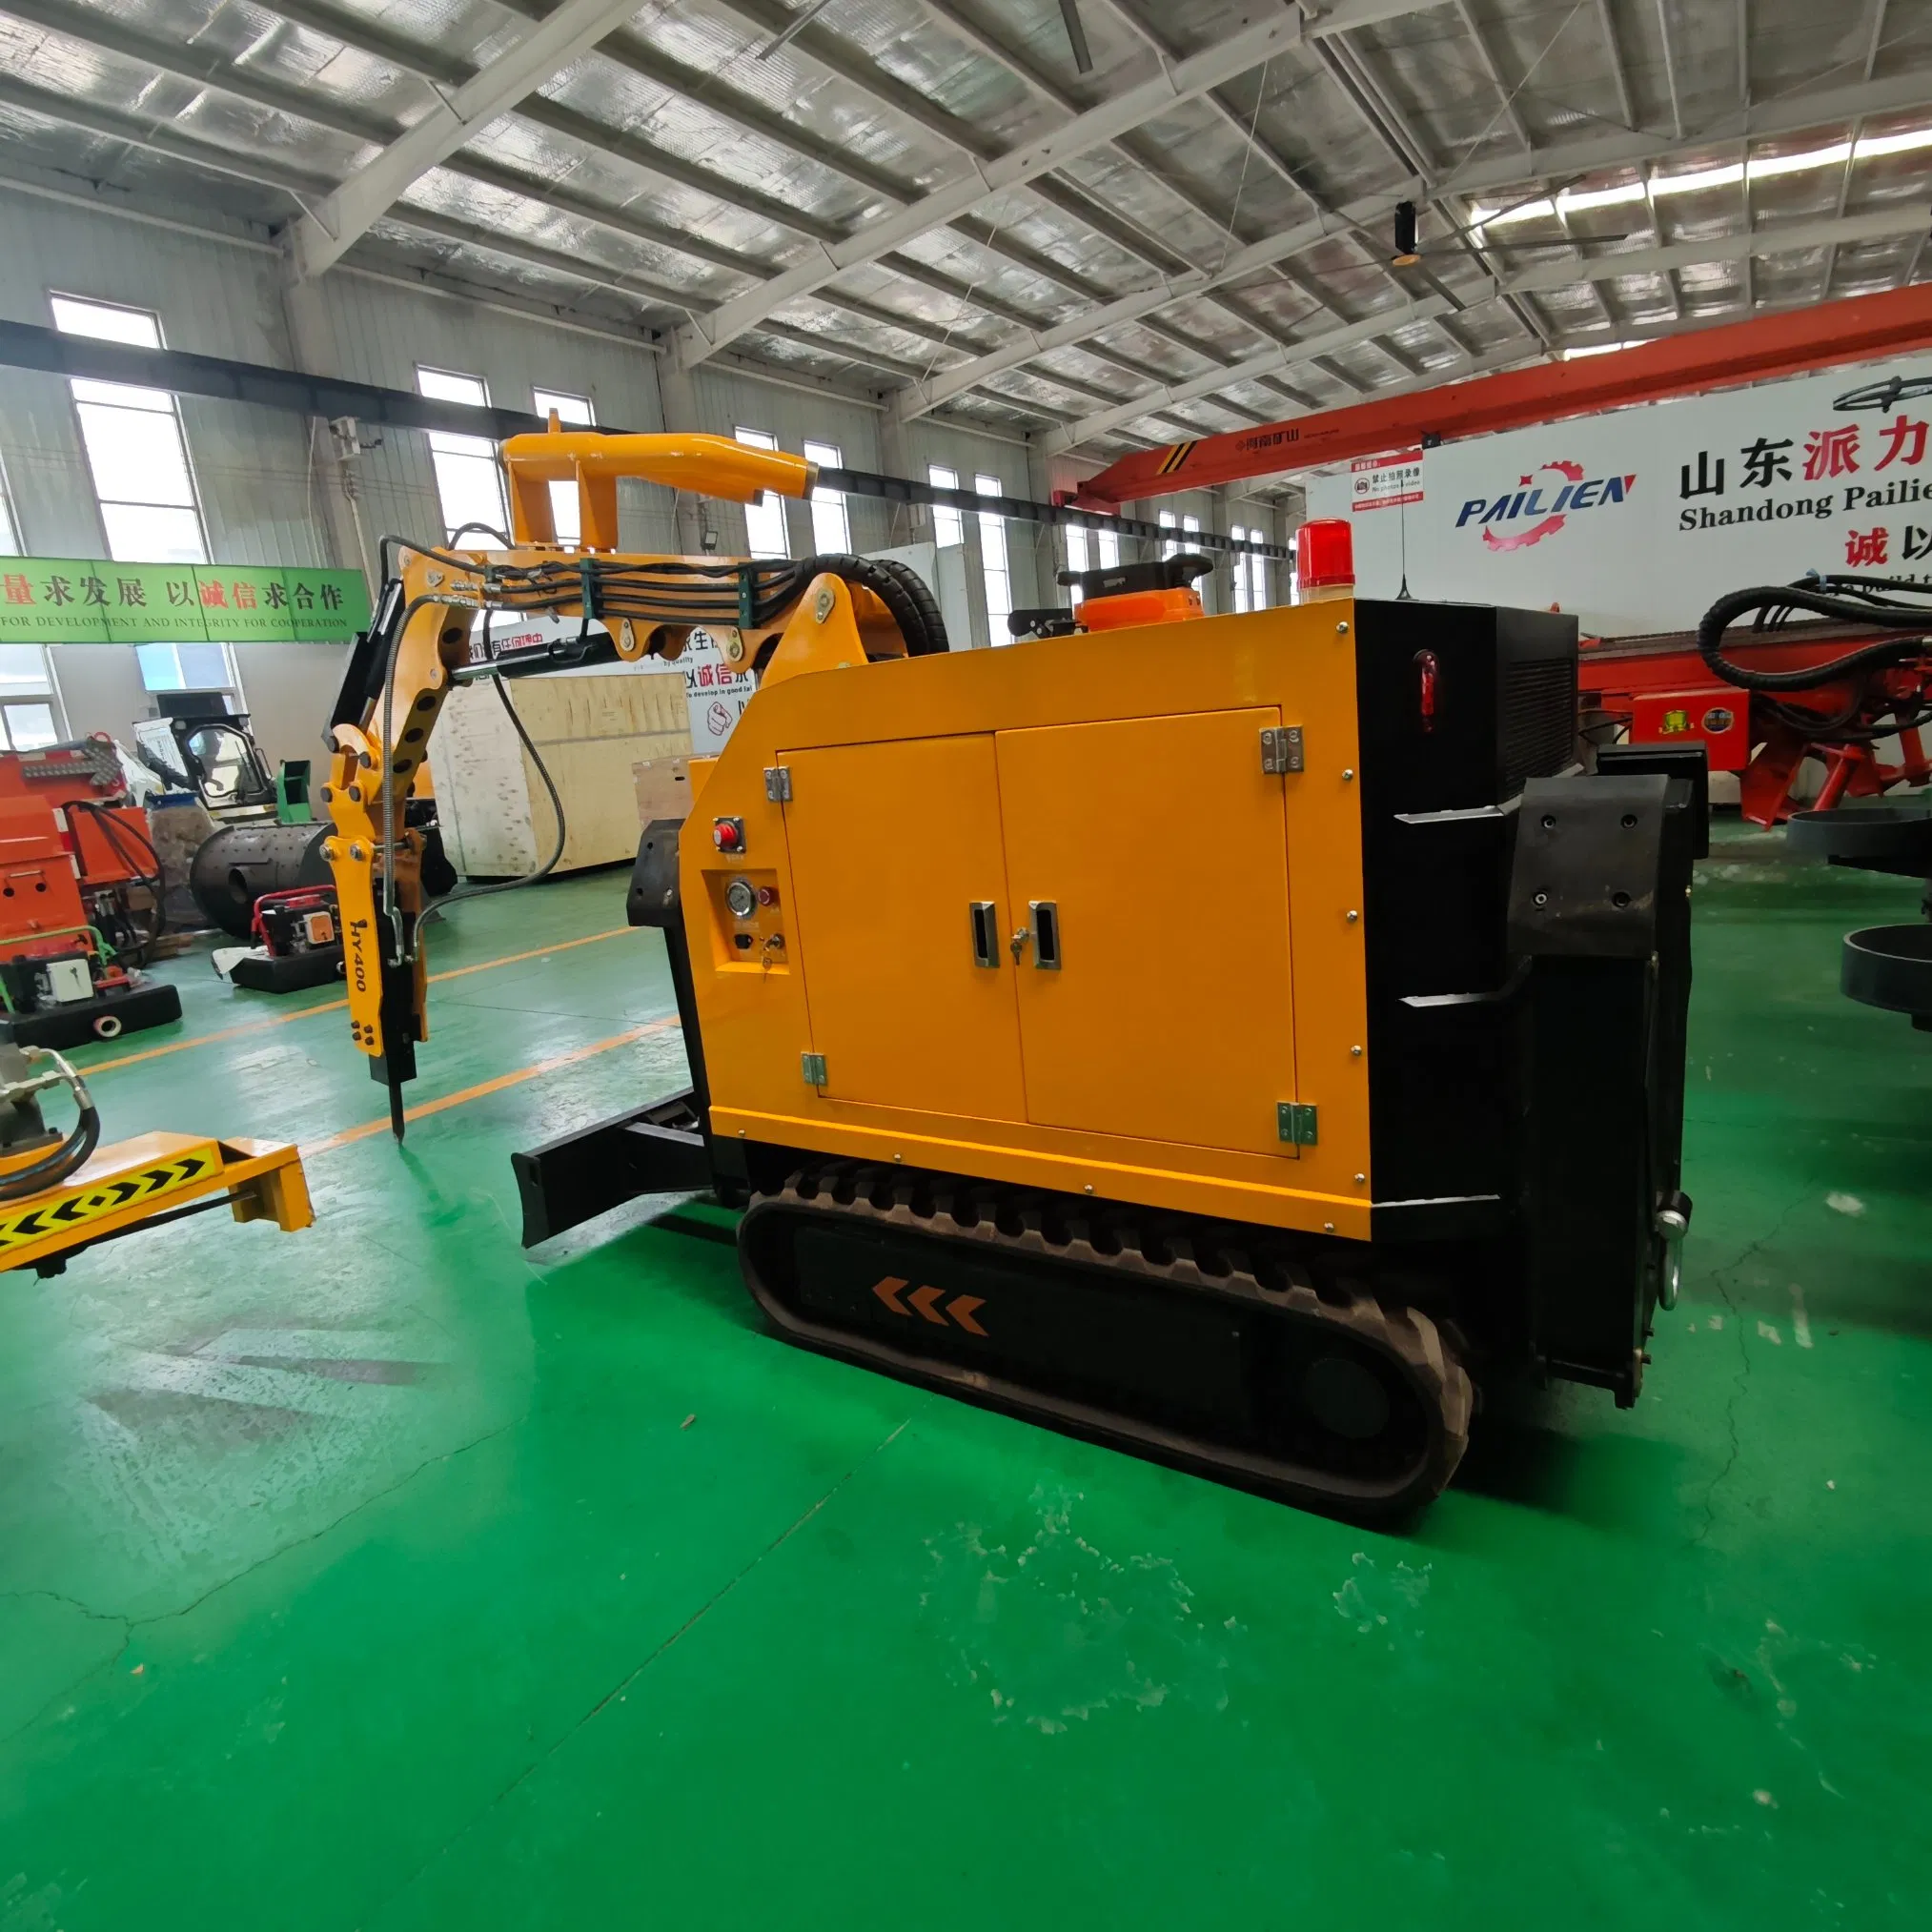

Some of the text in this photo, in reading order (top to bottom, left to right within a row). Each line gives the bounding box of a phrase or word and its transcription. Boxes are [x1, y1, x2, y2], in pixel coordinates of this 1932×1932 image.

[1373, 467, 1419, 483] 禁止拍照录像
[1679, 415, 1930, 499] 山东派力
[1455, 475, 1637, 528] PAILIEN
[1678, 495, 1834, 531] Shandong
[0, 574, 343, 611] 量求发展 以诚信求合作
[36, 616, 138, 628] DEVELOPMENT
[143, 618, 170, 628] AND
[174, 618, 240, 628] INTEGRITY
[244, 618, 268, 628] FOR
[271, 618, 347, 628] COOPERATION
[694, 688, 719, 698] develop
[727, 685, 742, 695] good
[349, 919, 367, 992] HY400
